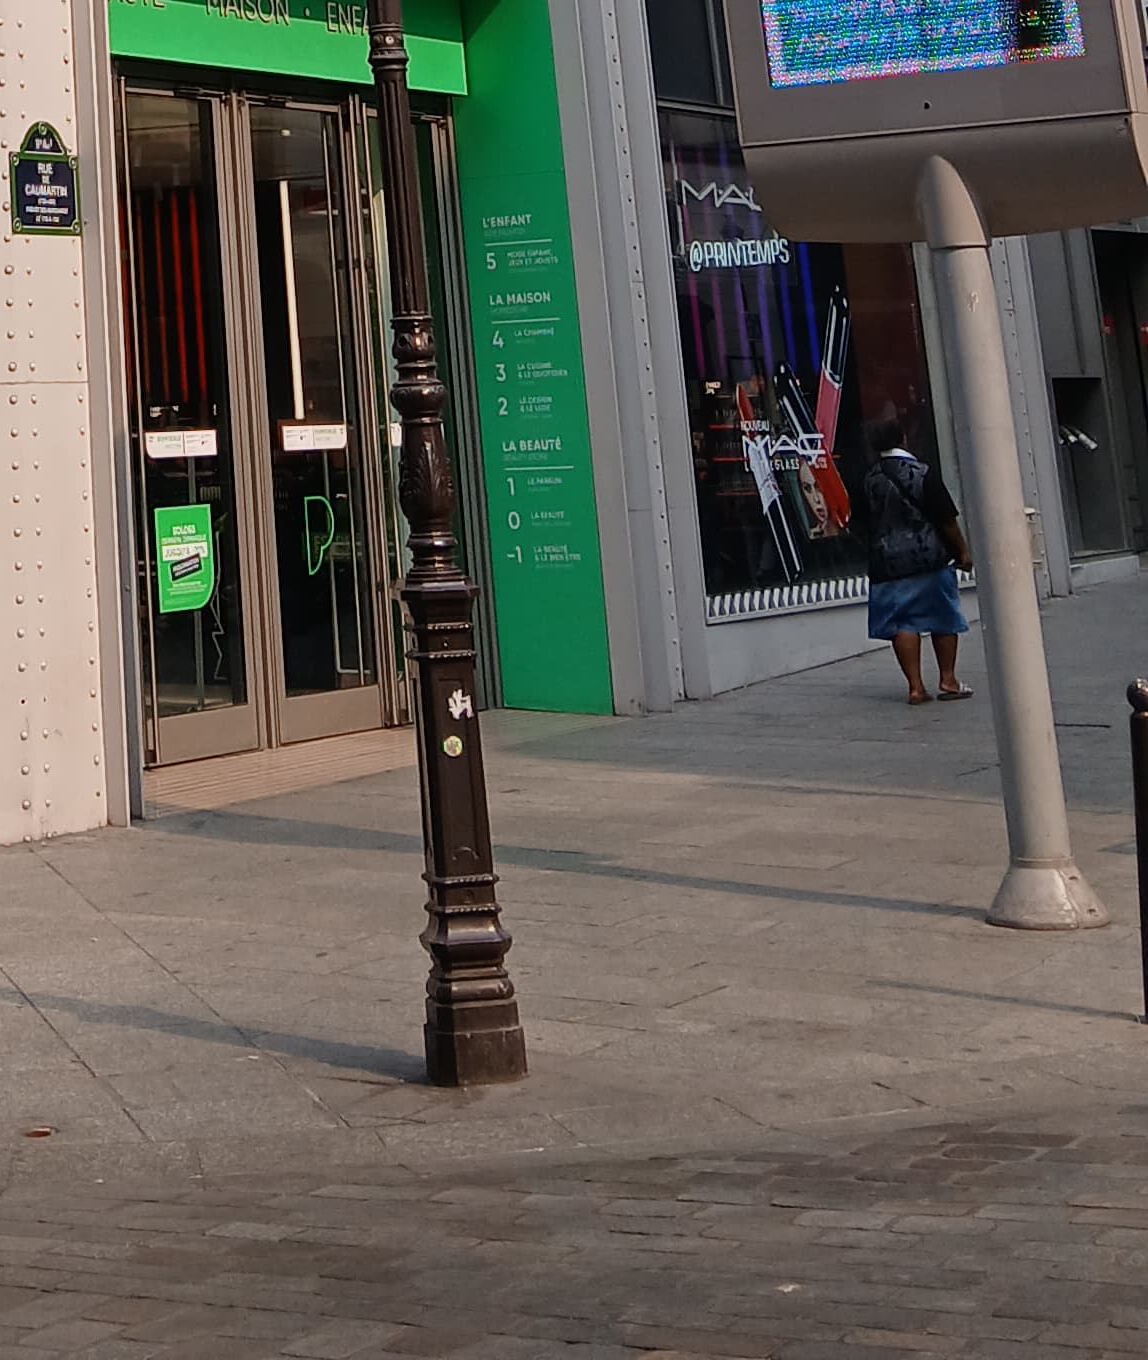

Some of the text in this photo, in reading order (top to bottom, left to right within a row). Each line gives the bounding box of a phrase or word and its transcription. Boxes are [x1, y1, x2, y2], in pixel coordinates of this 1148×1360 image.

[37, 162, 54, 175] RUE
[482, 213, 533, 229] L'ENFANT
[486, 252, 497, 271] 5
[689, 237, 791, 272] @PRINTEMPS
[489, 291, 551, 306] LA MAISON
[492, 330, 504, 348] 4
[496, 363, 507, 382] 3
[498, 396, 509, 416] 2
[502, 436, 562, 452] LA BEAUTÉ
[507, 477, 515, 496] 1
[508, 511, 520, 530] 0
[507, 545, 523, 564] -1
